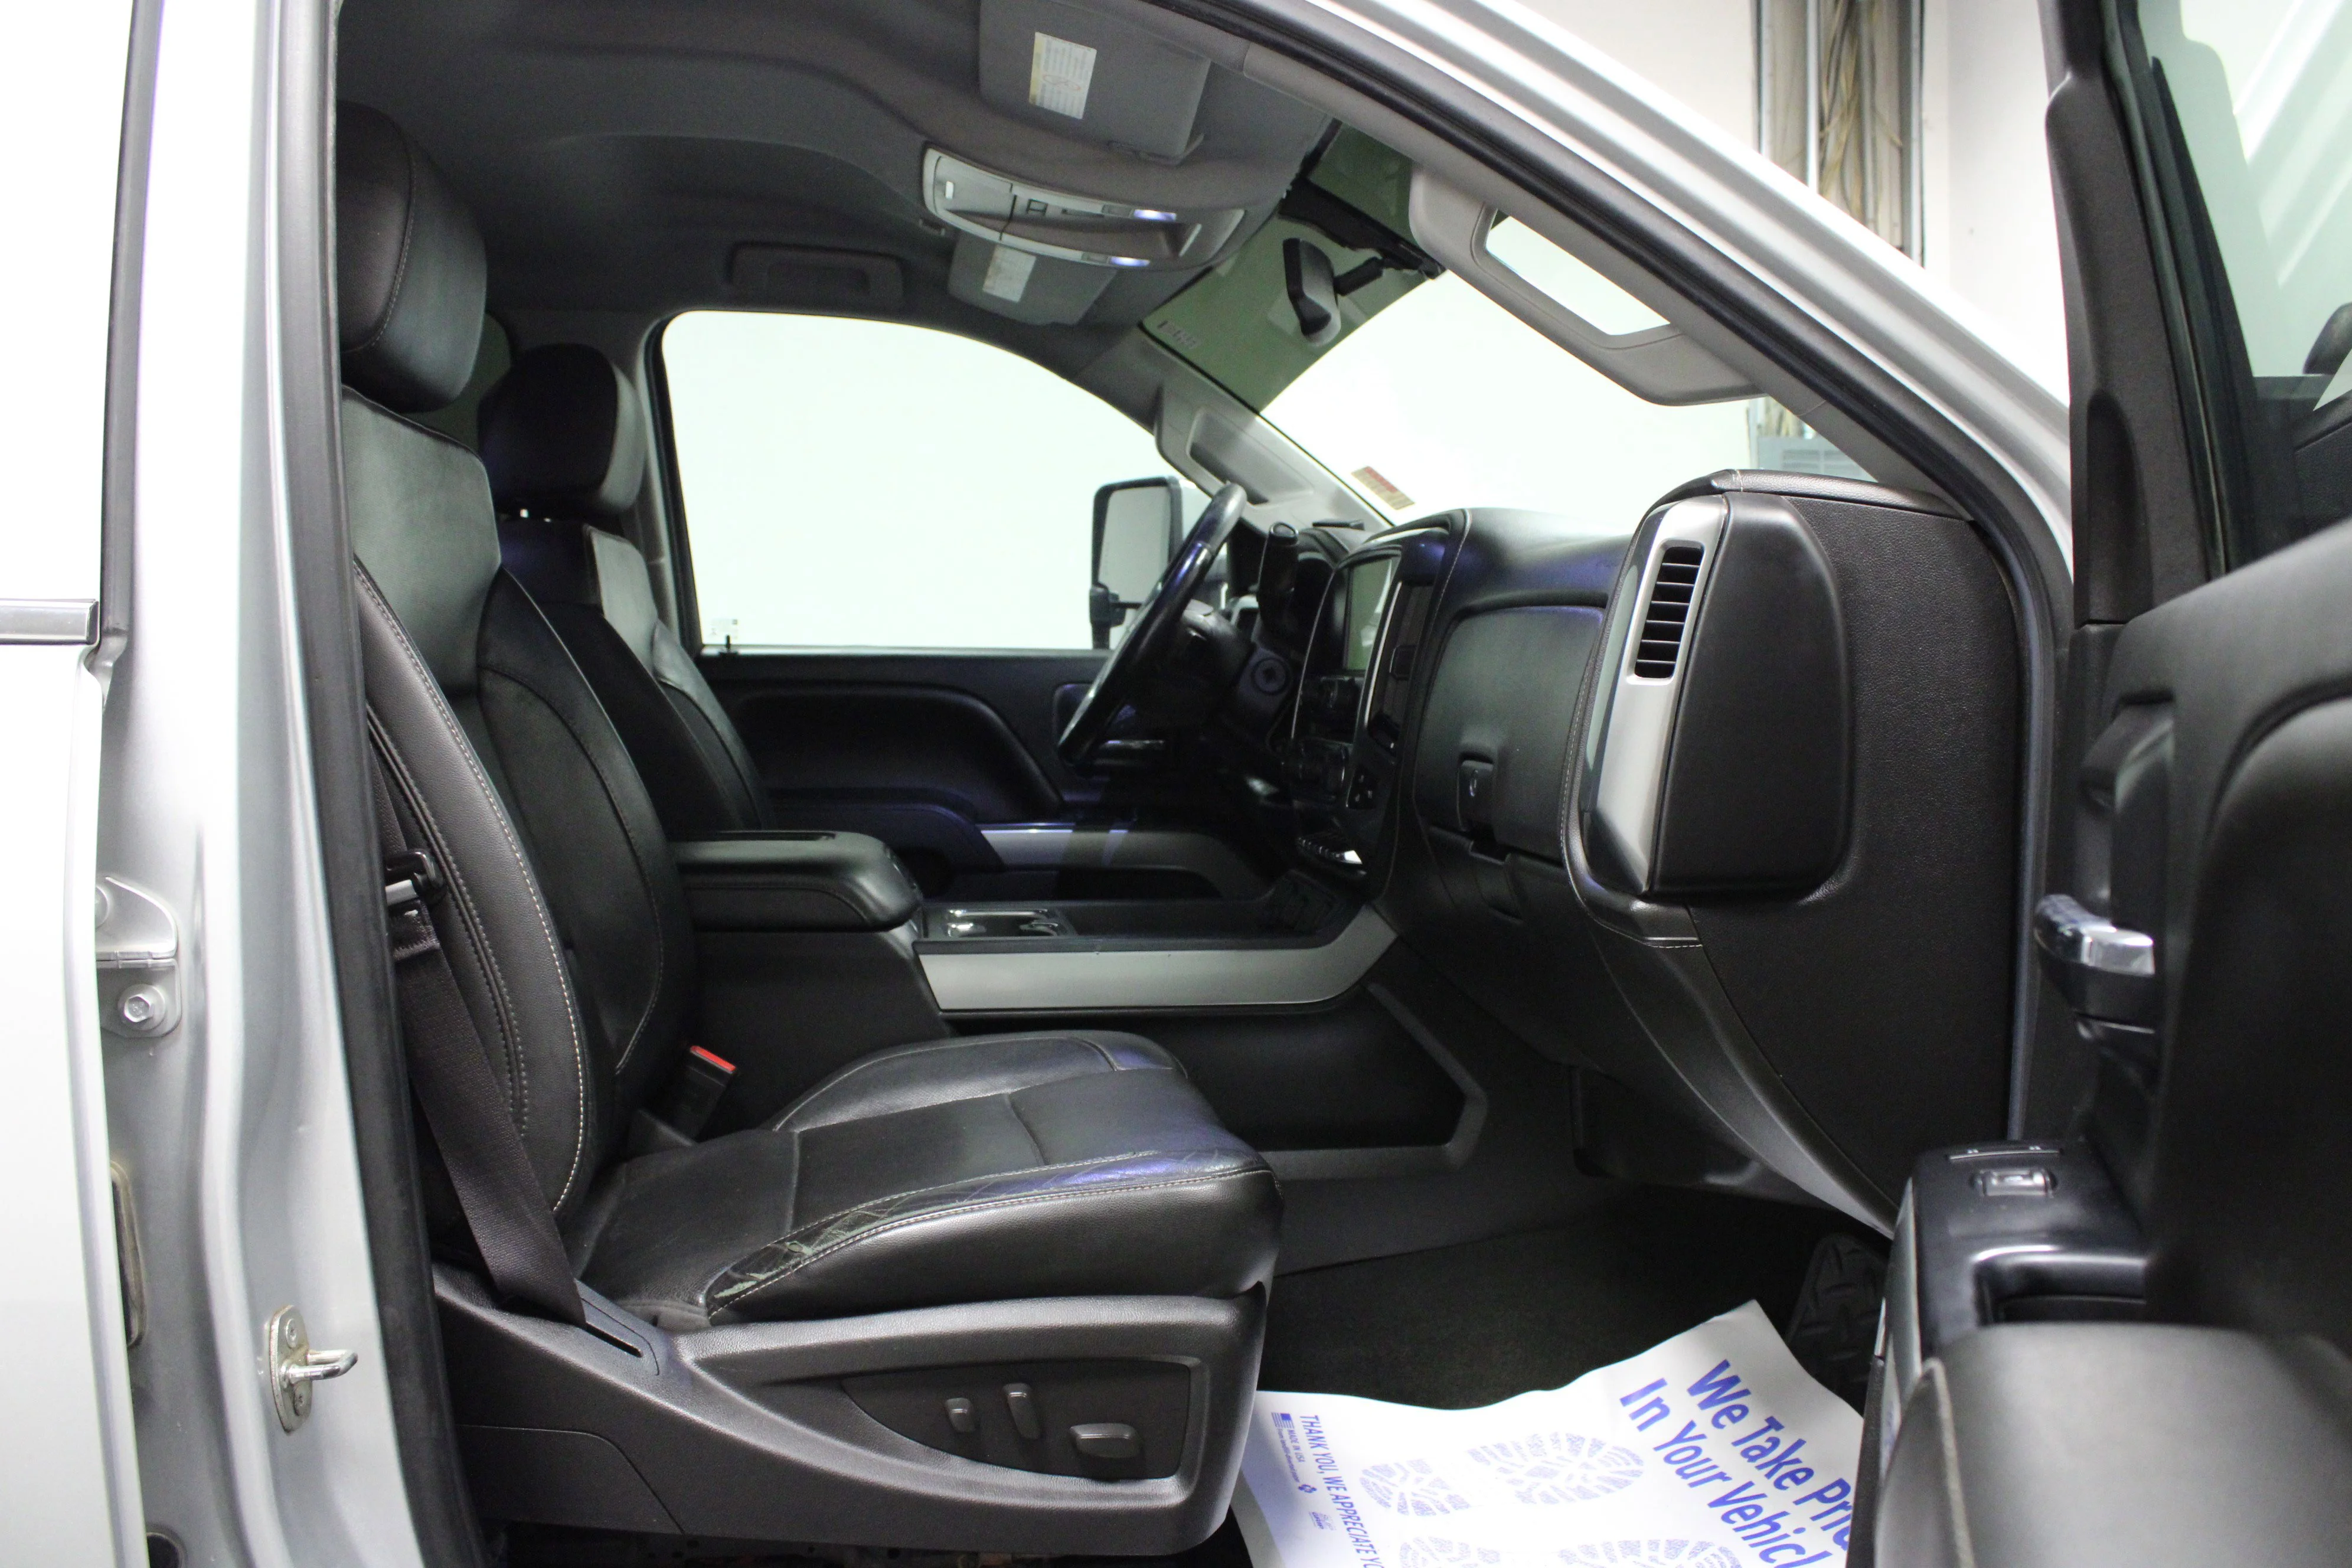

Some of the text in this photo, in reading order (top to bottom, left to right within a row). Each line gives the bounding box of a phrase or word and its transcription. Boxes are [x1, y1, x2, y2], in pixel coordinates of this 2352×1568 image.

[1299, 1415, 1329, 1450] THANK
[1619, 1377, 1671, 1432] In
[1653, 1420, 1733, 1488] Your
[1687, 1359, 1751, 1429] We
[1731, 1416, 1815, 1491] Take
[1287, 1429, 1299, 1444] MADE
[1295, 1452, 1305, 1462] USA
[1312, 1453, 1339, 1474] YOU,
[1322, 1476, 1348, 1491] WE
[1329, 1494, 1378, 1554] APPRECIATE
